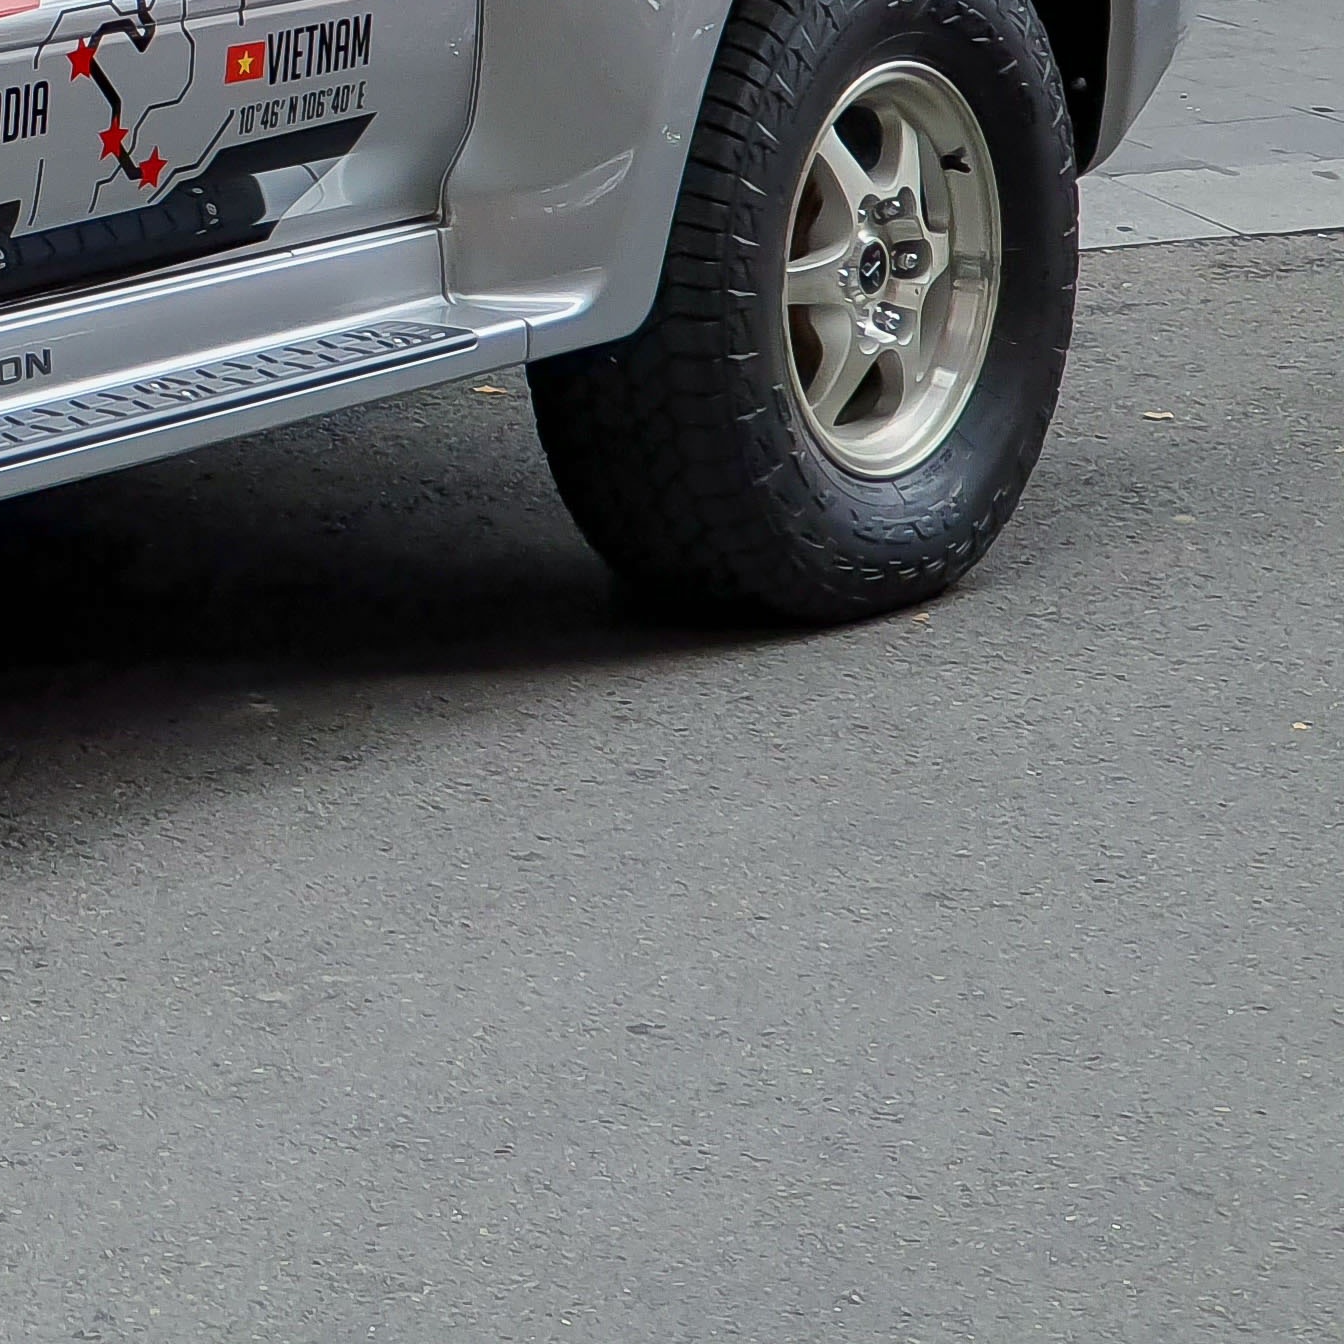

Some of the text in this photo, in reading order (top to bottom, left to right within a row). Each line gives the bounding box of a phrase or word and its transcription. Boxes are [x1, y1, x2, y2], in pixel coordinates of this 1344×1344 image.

[267, 13, 372, 85] VIETNAM
[287, 95, 298, 125] N
[356, 81, 367, 109] E
